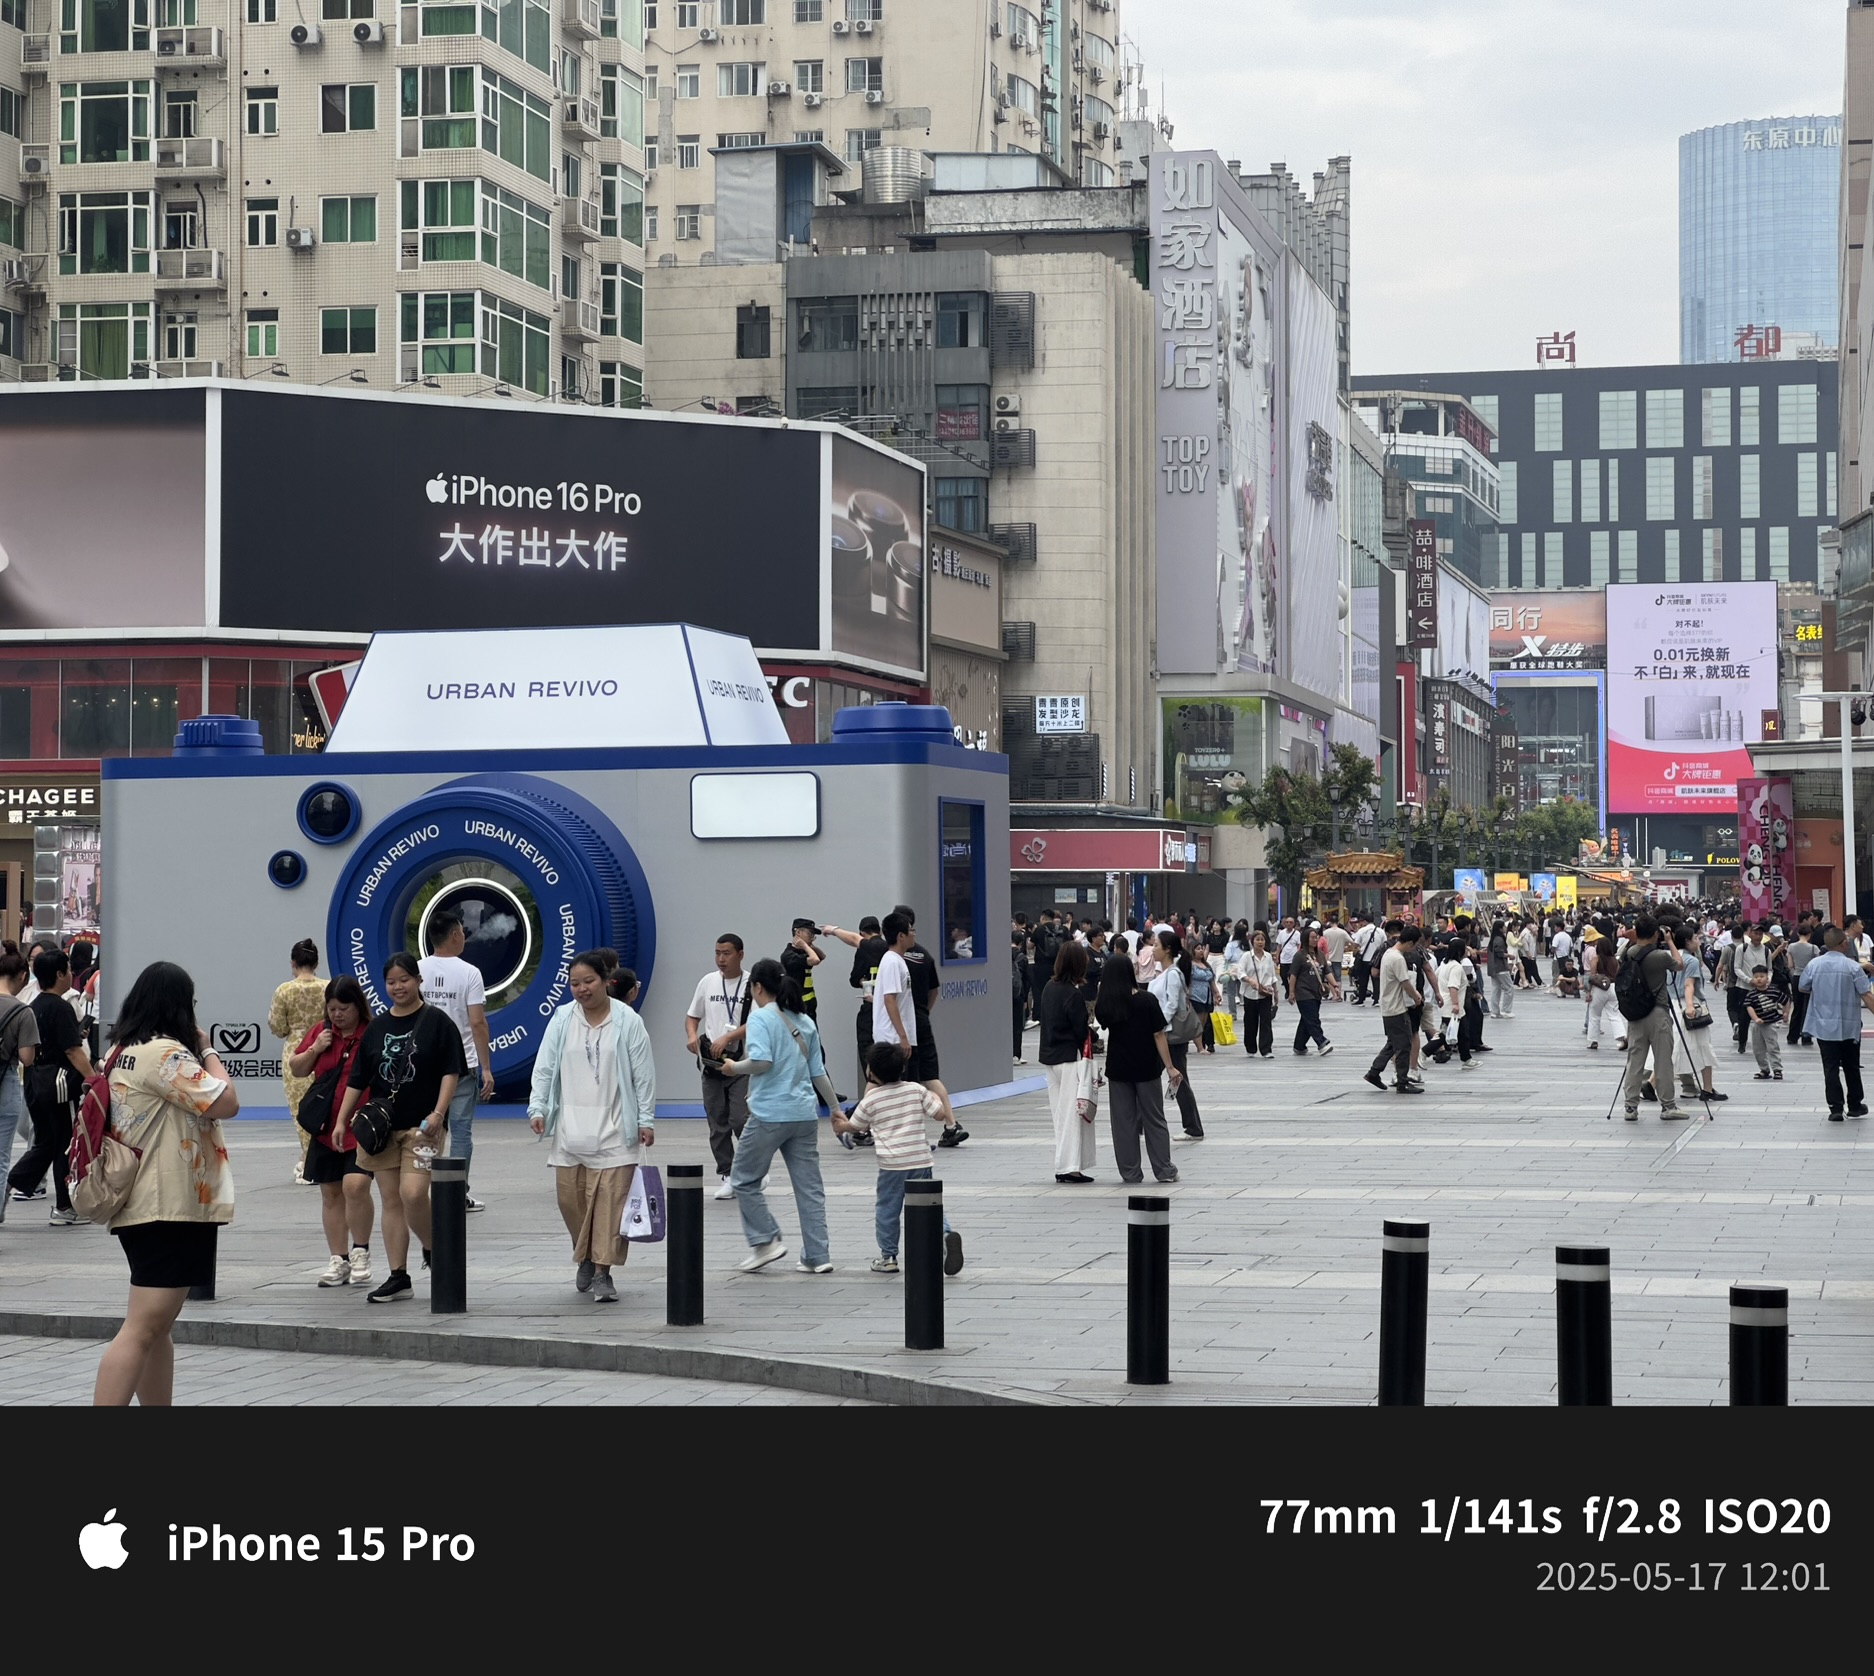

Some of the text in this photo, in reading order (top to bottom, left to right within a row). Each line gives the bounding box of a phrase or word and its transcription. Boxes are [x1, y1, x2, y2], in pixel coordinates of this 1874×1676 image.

[1743, 126, 1841, 152] 东原中心
[1158, 158, 1214, 390] 如家酒店
[1162, 435, 1210, 463] TOP
[1162, 464, 1210, 494] TOY
[451, 474, 642, 515] iPhone 16 Pro
[438, 522, 628, 571] 大作出大作
[1489, 606, 1542, 631] 同行
[1545, 642, 1585, 657] 特步
[1653, 647, 1730, 662] 0.01元换新
[426, 679, 618, 700] URBAN REVIVO
[706, 679, 765, 703] URBAN REVIVO
[1039, 709, 1080, 719] 发型沙龙
[1188, 754, 1231, 767] LULU
[1760, 805, 1770, 860] CHENG
[357, 824, 440, 907] URBAN REVIVO
[465, 820, 560, 886] URBAN REVIVO
[1772, 854, 1783, 910] CHENG
[350, 927, 372, 986] REVIVO
[538, 903, 577, 1016] URBAN REVIVO
[941, 979, 987, 999] URBAN REVIVO
